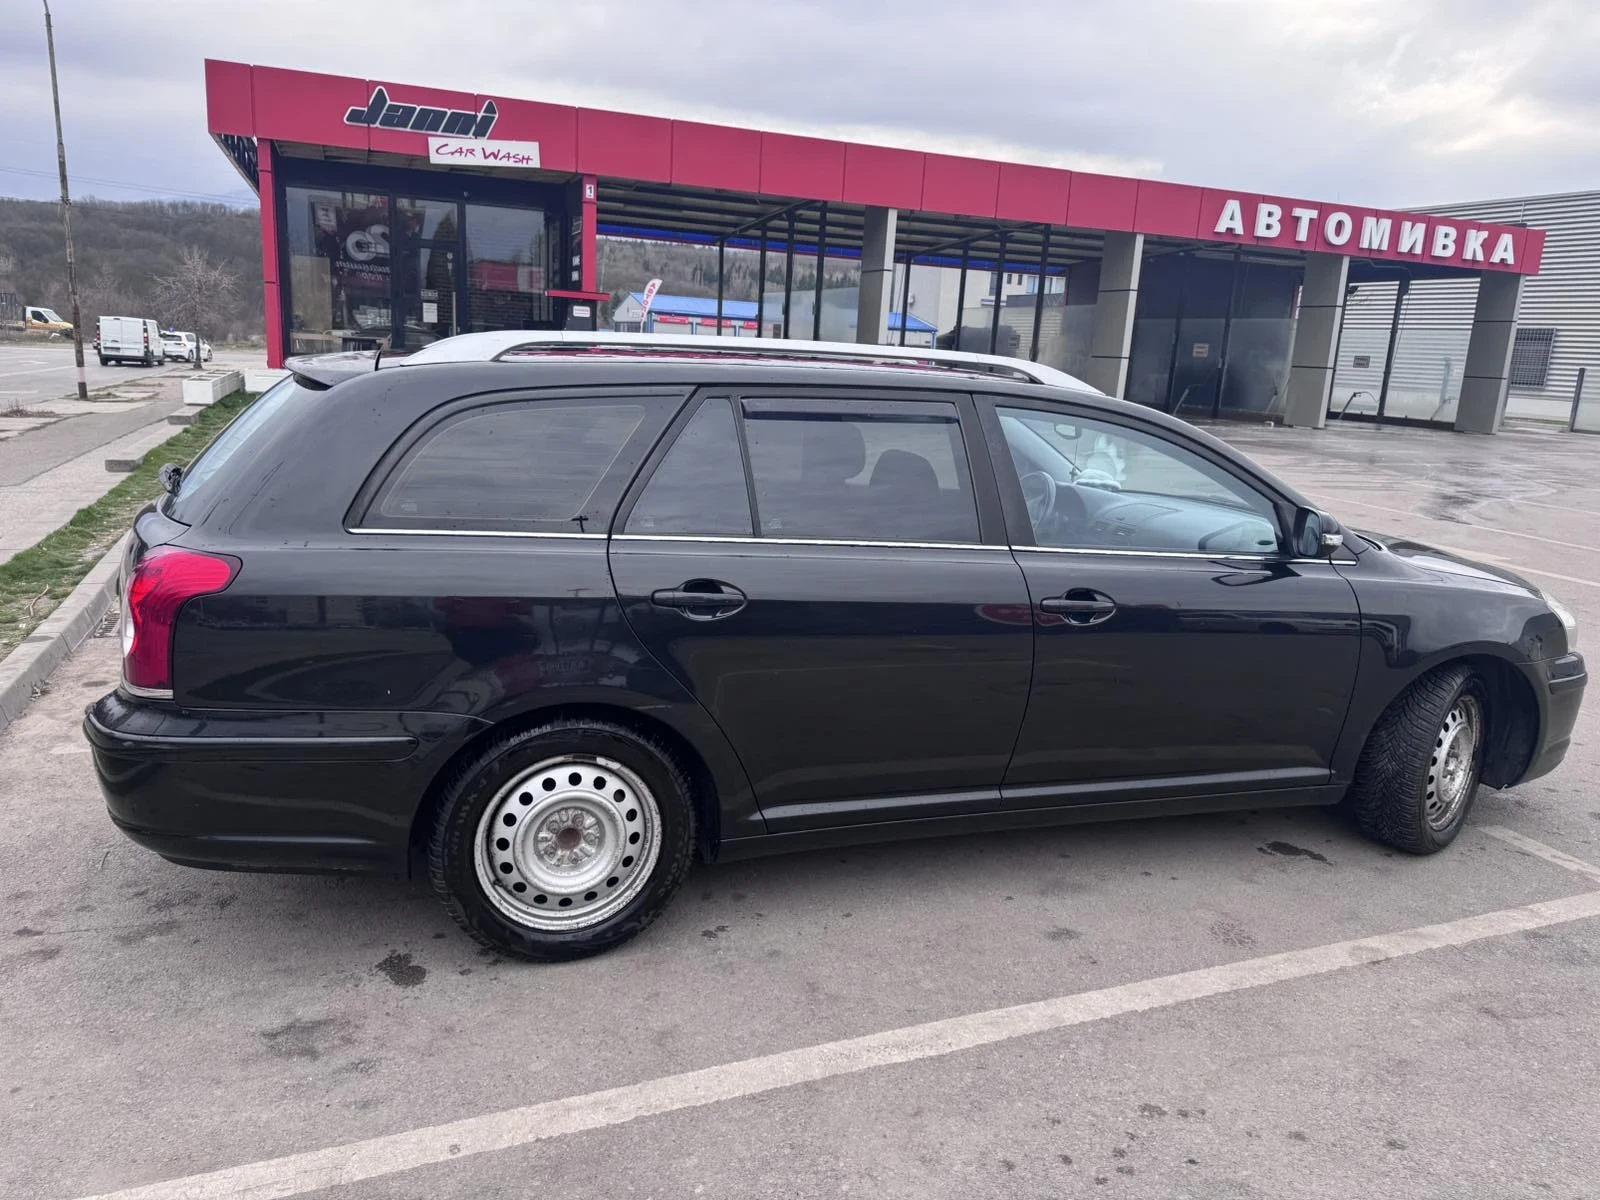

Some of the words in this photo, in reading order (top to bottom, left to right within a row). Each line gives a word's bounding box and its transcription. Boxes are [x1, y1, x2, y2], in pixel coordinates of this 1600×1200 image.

[435, 143, 476, 158] CAR
[482, 147, 533, 165] WASH
[1214, 199, 1515, 266] АВТОМИВКА
